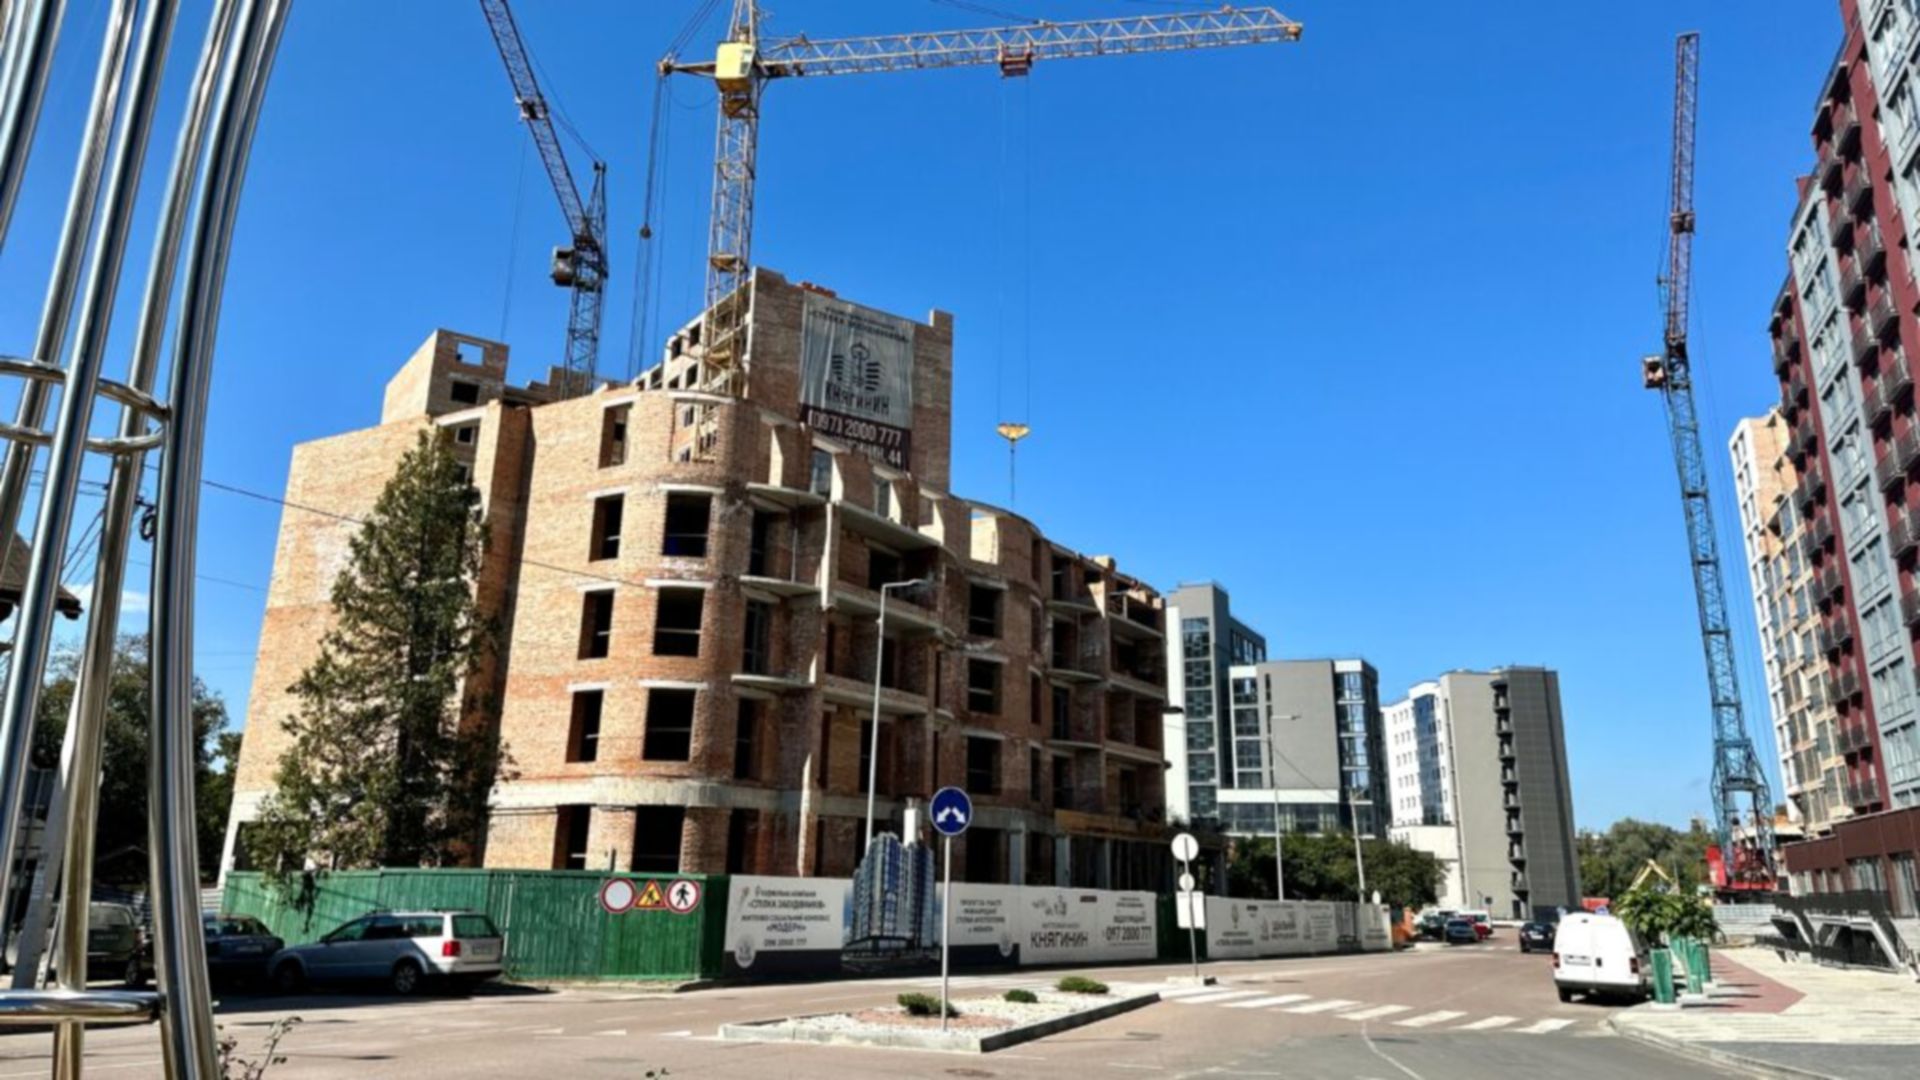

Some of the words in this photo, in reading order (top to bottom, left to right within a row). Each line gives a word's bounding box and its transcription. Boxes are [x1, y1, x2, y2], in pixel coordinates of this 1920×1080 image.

[825, 382, 890, 415] КНЯГИНИН
[844, 418, 877, 440] 2000
[878, 426, 902, 447] 777
[1030, 931, 1089, 948] КНЯГИНИН
